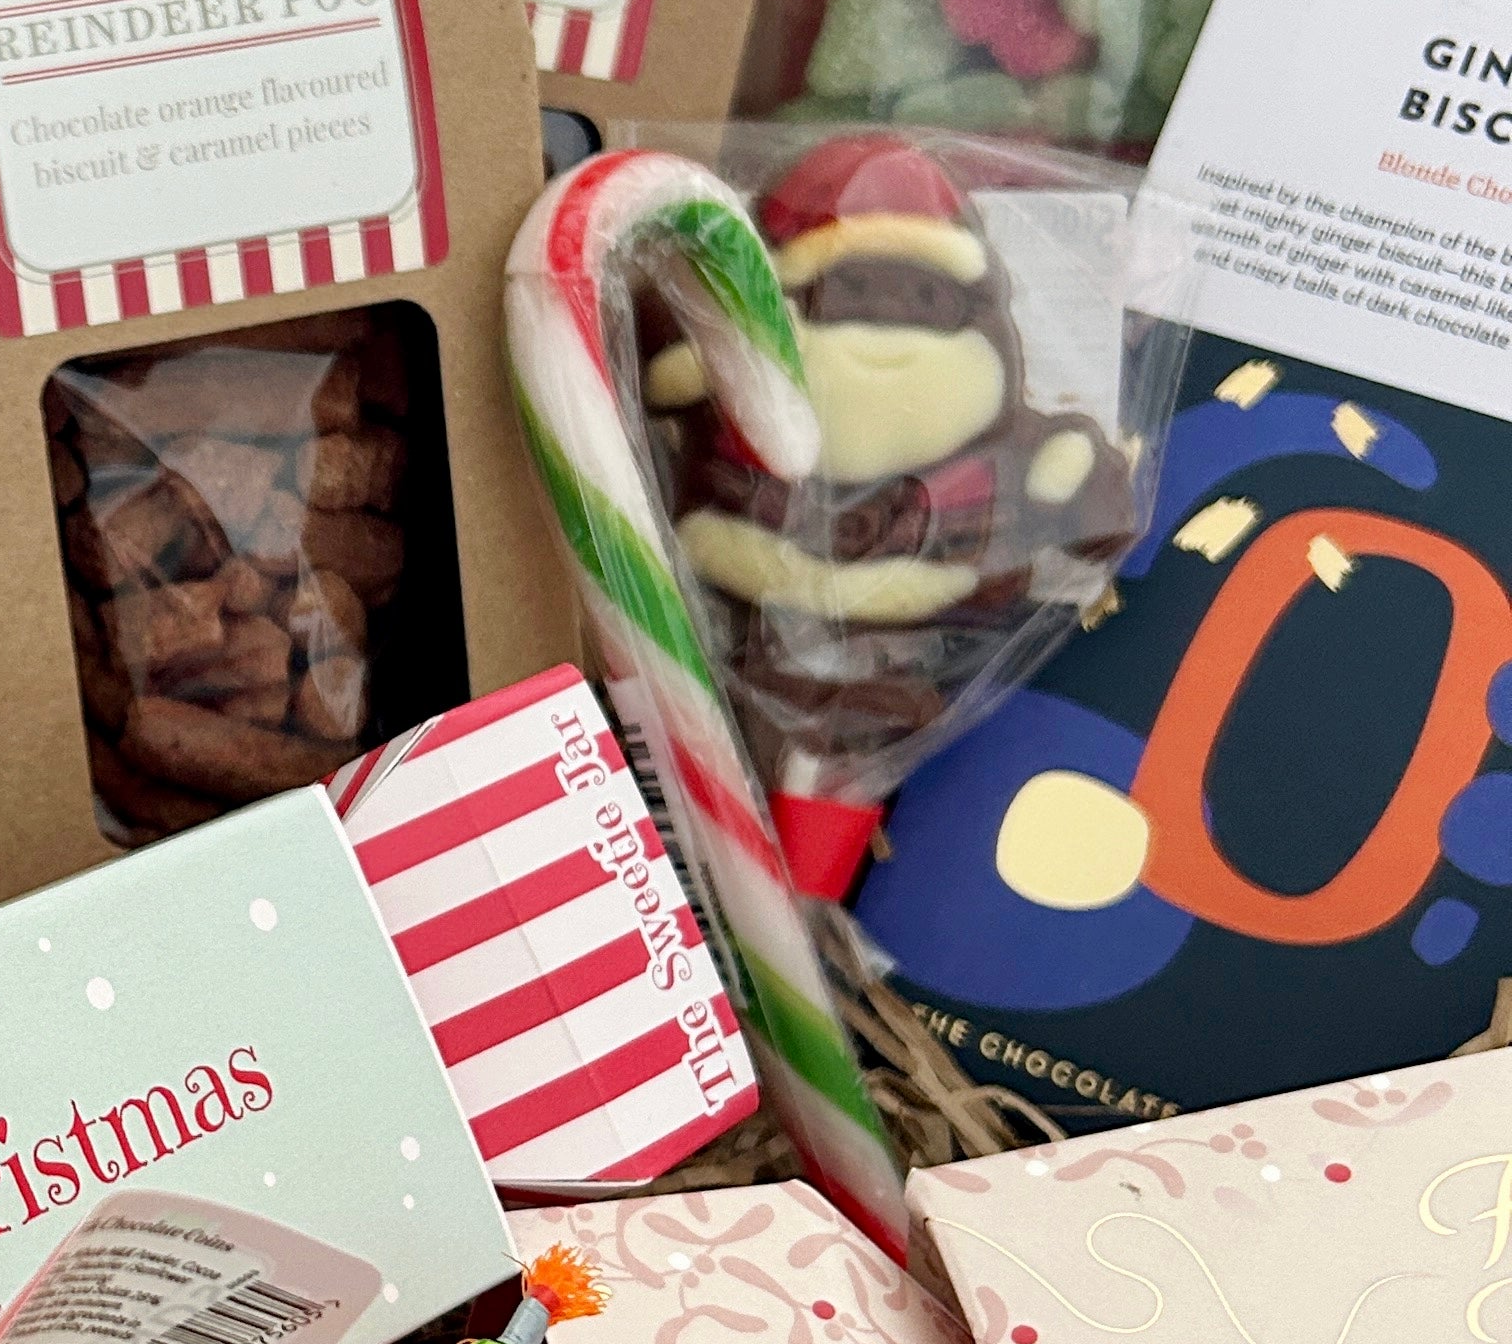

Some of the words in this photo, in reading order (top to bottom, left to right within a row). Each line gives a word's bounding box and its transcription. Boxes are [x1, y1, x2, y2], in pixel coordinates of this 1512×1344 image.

[10, 100, 151, 148] Chocolate
[159, 88, 253, 126] orange
[261, 60, 390, 108] flavoured
[33, 144, 131, 190] biscuit
[136, 143, 162, 171] &
[168, 124, 281, 169] caramel
[287, 111, 372, 154] pieces
[1377, 149, 1462, 192] Blonde
[1198, 163, 1276, 200] Inspired
[1277, 183, 1302, 207] by
[1305, 192, 1337, 218] the
[1340, 205, 1436, 244] champion
[1440, 230, 1465, 251] of
[1465, 235, 1497, 262] the
[1243, 204, 1308, 240] mighty
[1311, 222, 1375, 254] ginger
[1234, 258, 1289, 290] crispy
[1293, 269, 1339, 301] balls
[1343, 286, 1366, 307] of
[1366, 294, 1412, 321] dark
[1414, 308, 1510, 351] chocolate
[1265, 236, 1288, 257] of
[1287, 245, 1351, 275] ginger
[1354, 261, 1397, 288] with
[550, 709, 606, 797] Jar
[592, 800, 692, 992] Sweetie
[680, 1001, 736, 1110] The
[978, 1031, 1183, 1120] CHOCOLATE
